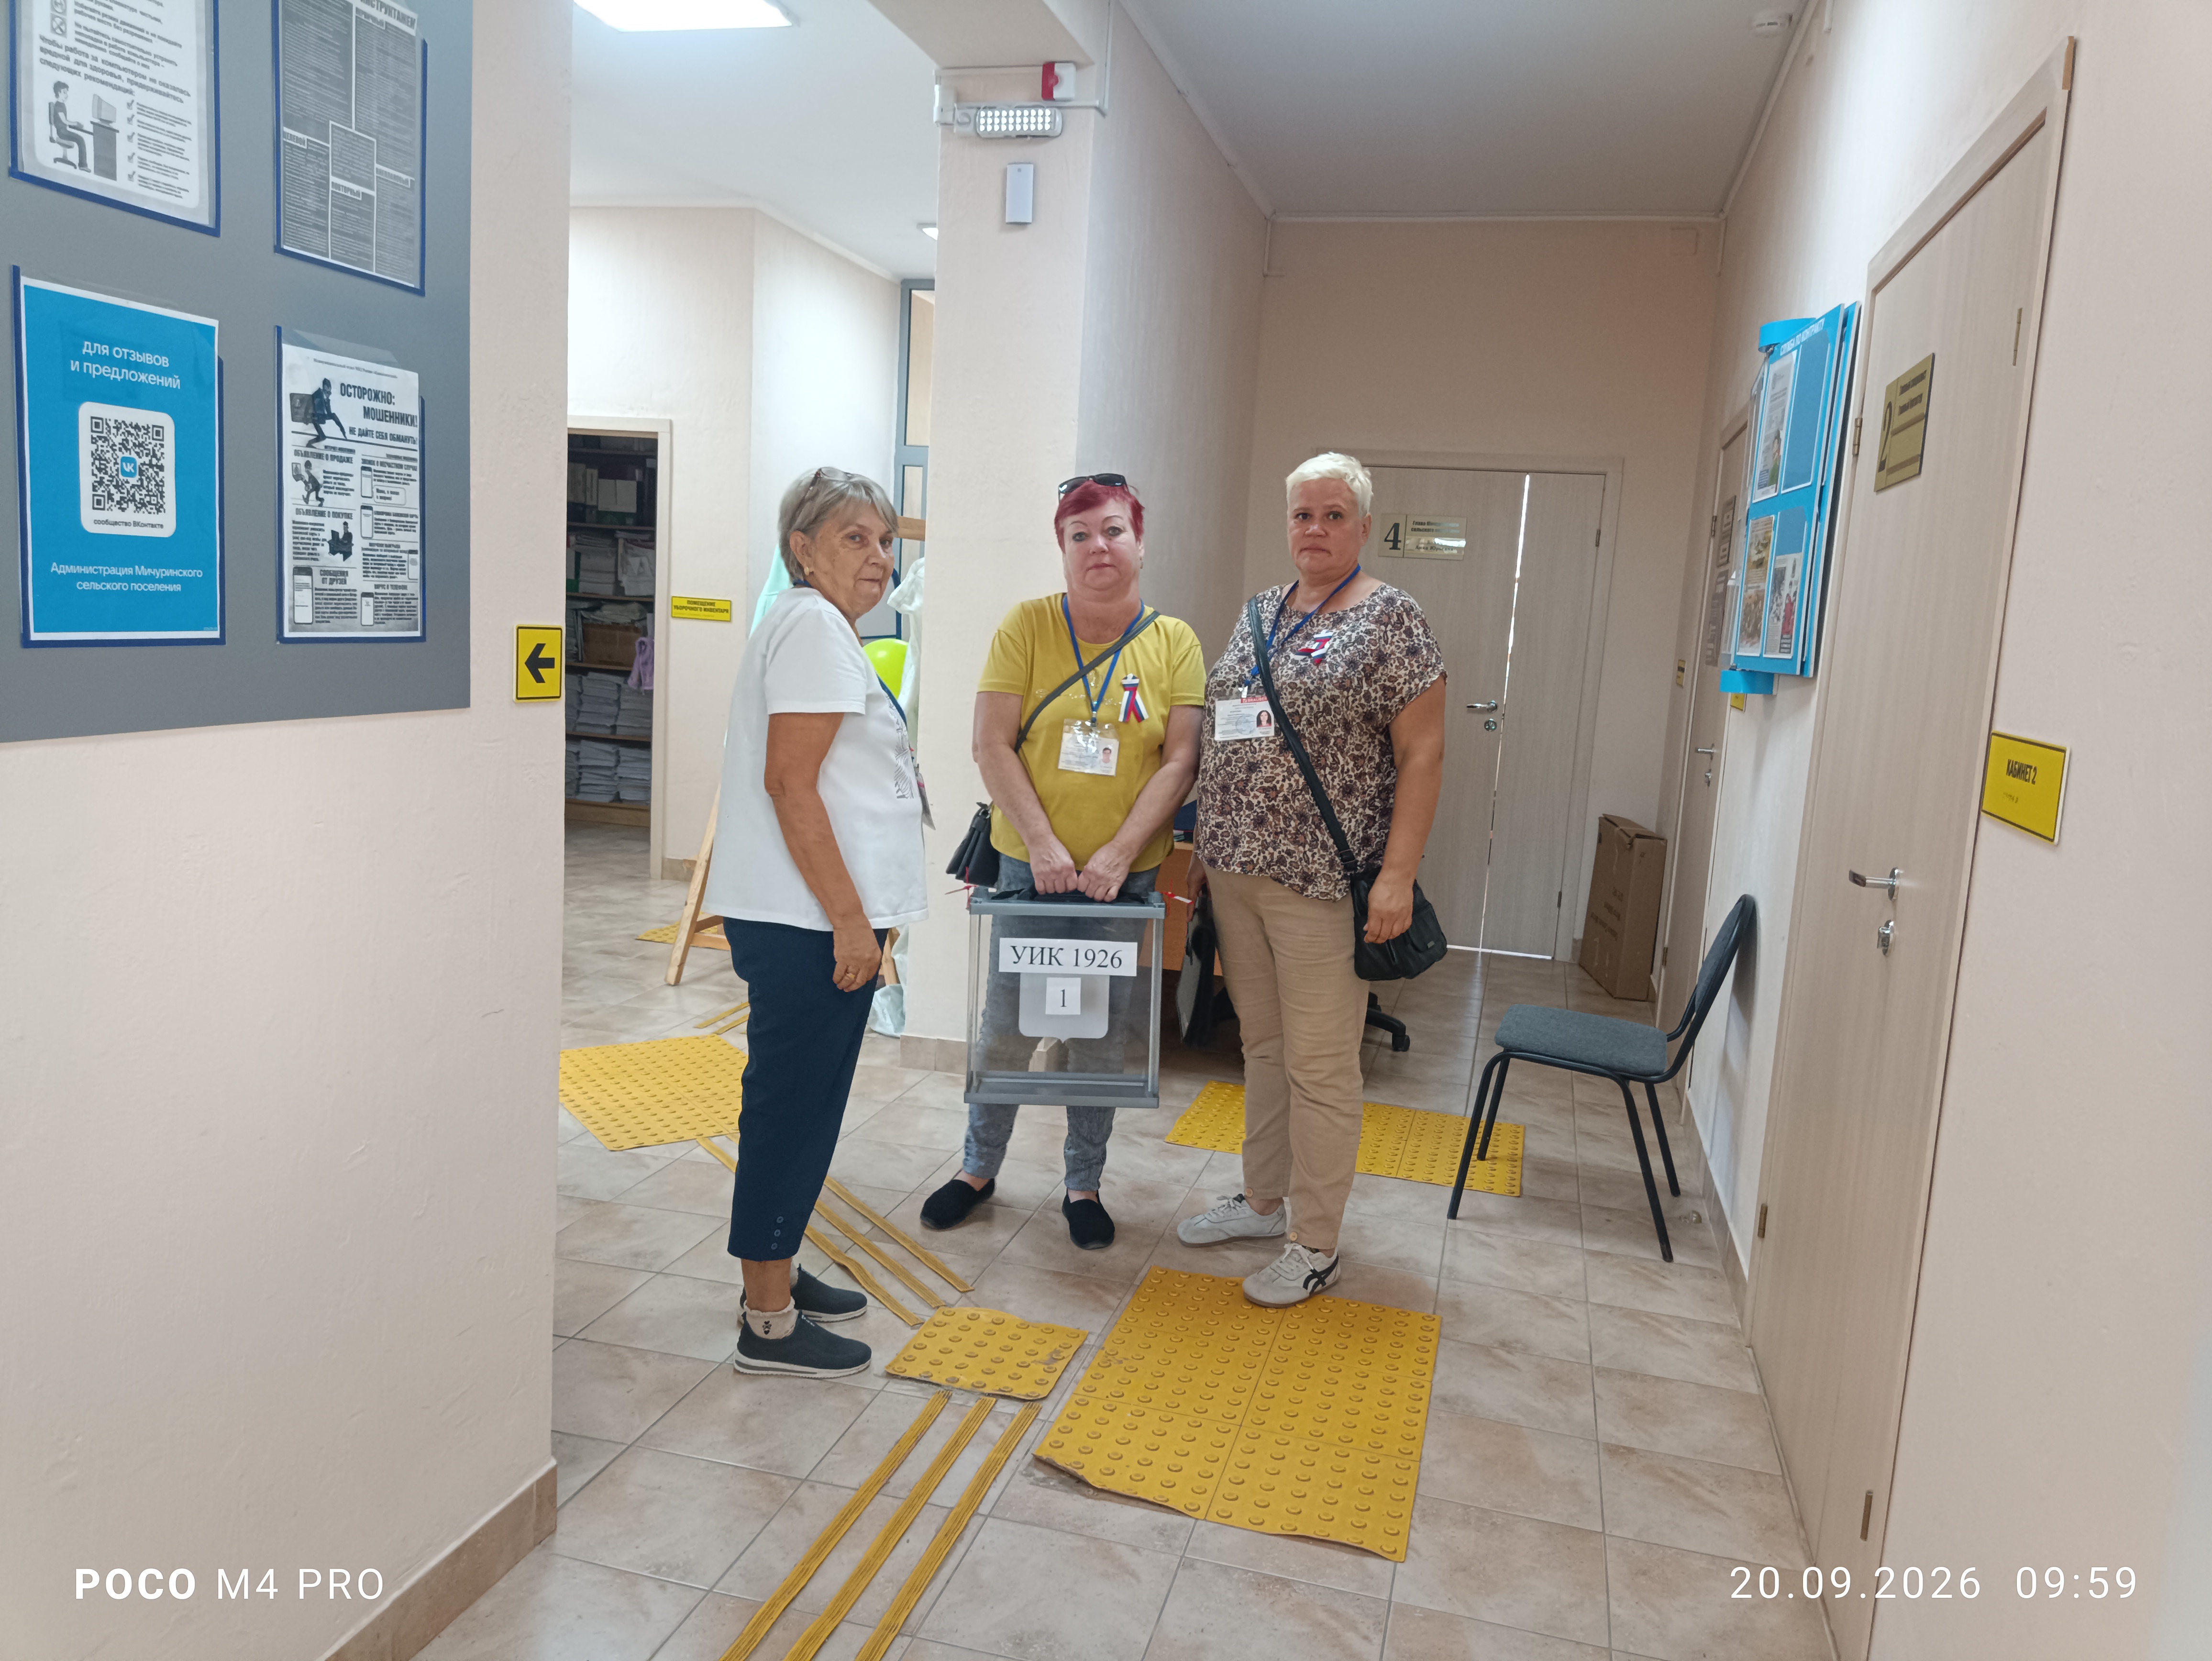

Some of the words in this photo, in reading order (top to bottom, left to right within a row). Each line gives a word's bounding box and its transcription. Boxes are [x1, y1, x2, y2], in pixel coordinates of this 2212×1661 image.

[65, 45, 89, 59] работа
[82, 341, 109, 356] для
[112, 347, 169, 367] отзывов
[70, 360, 79, 372] и
[83, 362, 180, 389] предложений
[340, 383, 395, 405] ОСТОРОЖНО:
[363, 406, 418, 428] МОШЕННИКИ!
[349, 426, 356, 435] НЕ
[358, 427, 374, 438] ДАЙТЕ
[376, 431, 387, 440] СЕБЯ
[389, 433, 418, 445] ОБМАНУТЬ!
[94, 519, 132, 527] сообщество
[133, 520, 164, 529] ВКонтакте
[1384, 522, 1402, 550] 4
[51, 562, 133, 577] Администрация
[135, 565, 203, 579] Мичуринского
[77, 581, 128, 591] сельского
[131, 582, 181, 592] поселения
[2006, 759, 2033, 783] КАБИНЕТ
[2031, 766, 2037, 785] 2
[1010, 945, 1064, 966] УИК
[1073, 948, 1123, 969] 1926
[1060, 989, 1067, 1008] 1
